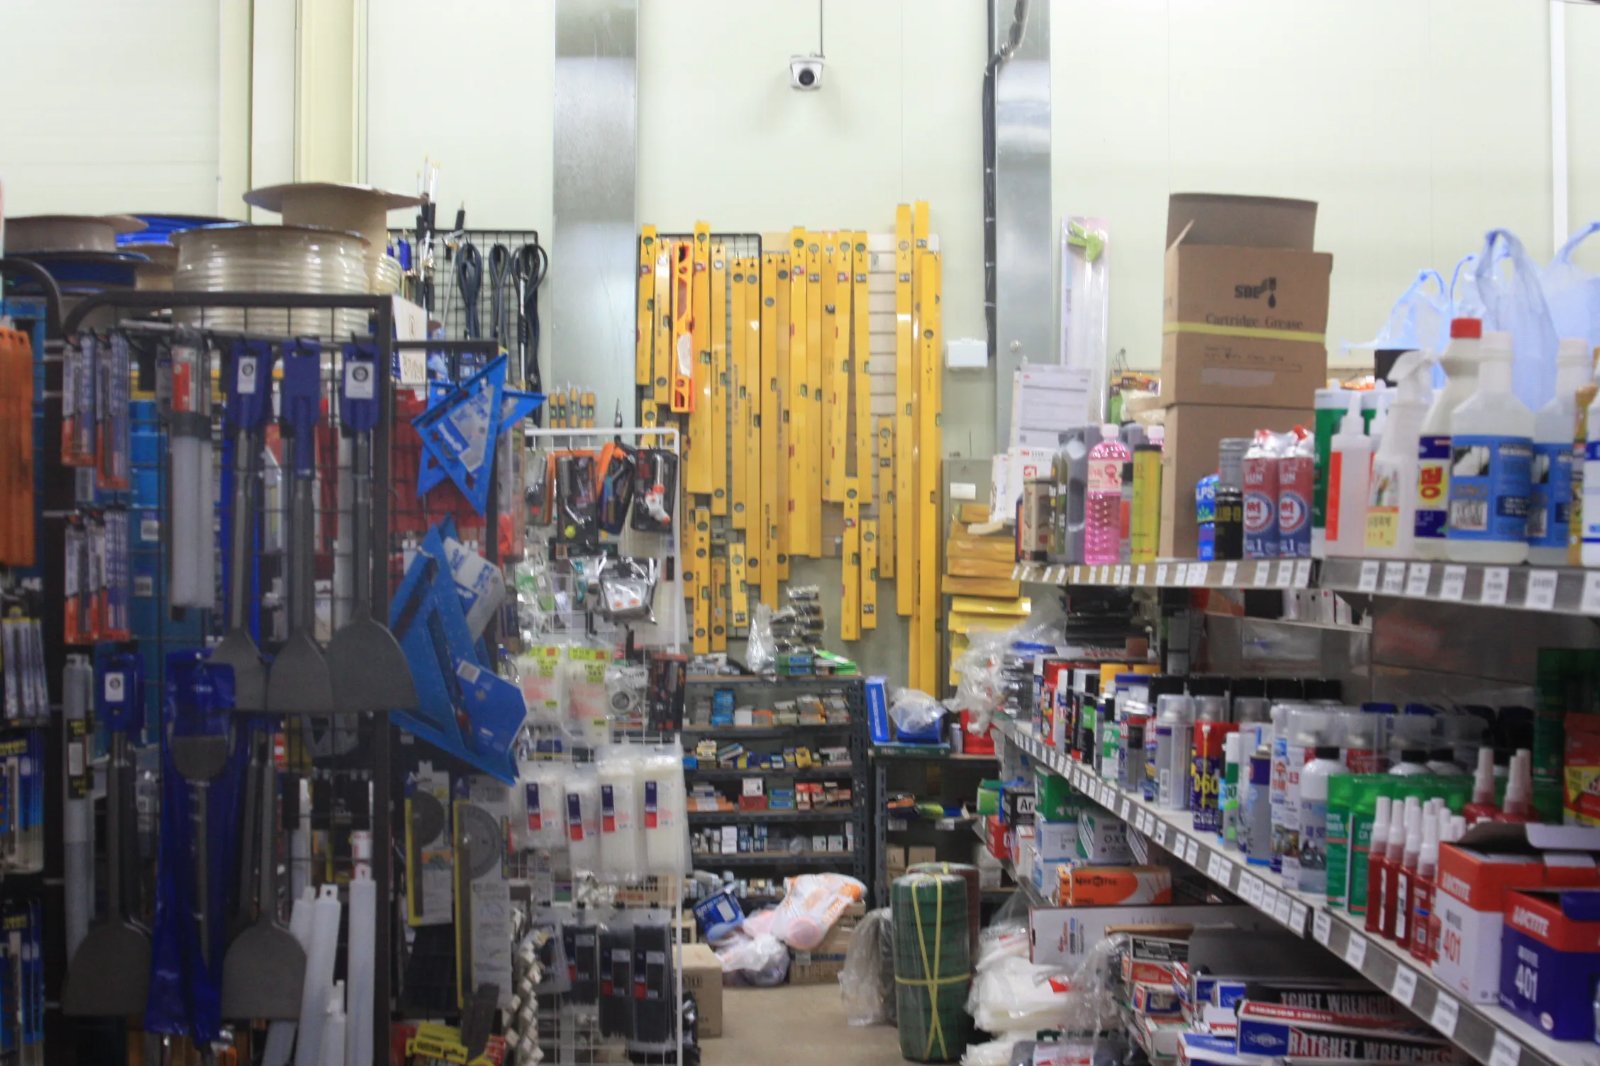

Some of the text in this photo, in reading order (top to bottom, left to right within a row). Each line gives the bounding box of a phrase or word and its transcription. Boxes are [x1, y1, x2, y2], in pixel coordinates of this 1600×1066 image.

[1442, 871, 1471, 902] LOCTITE
[1512, 906, 1549, 938] LOCTITE
[1443, 928, 1461, 966] 401
[1514, 963, 1537, 1003] 401
[1289, 1030, 1357, 1060] RATCHET
